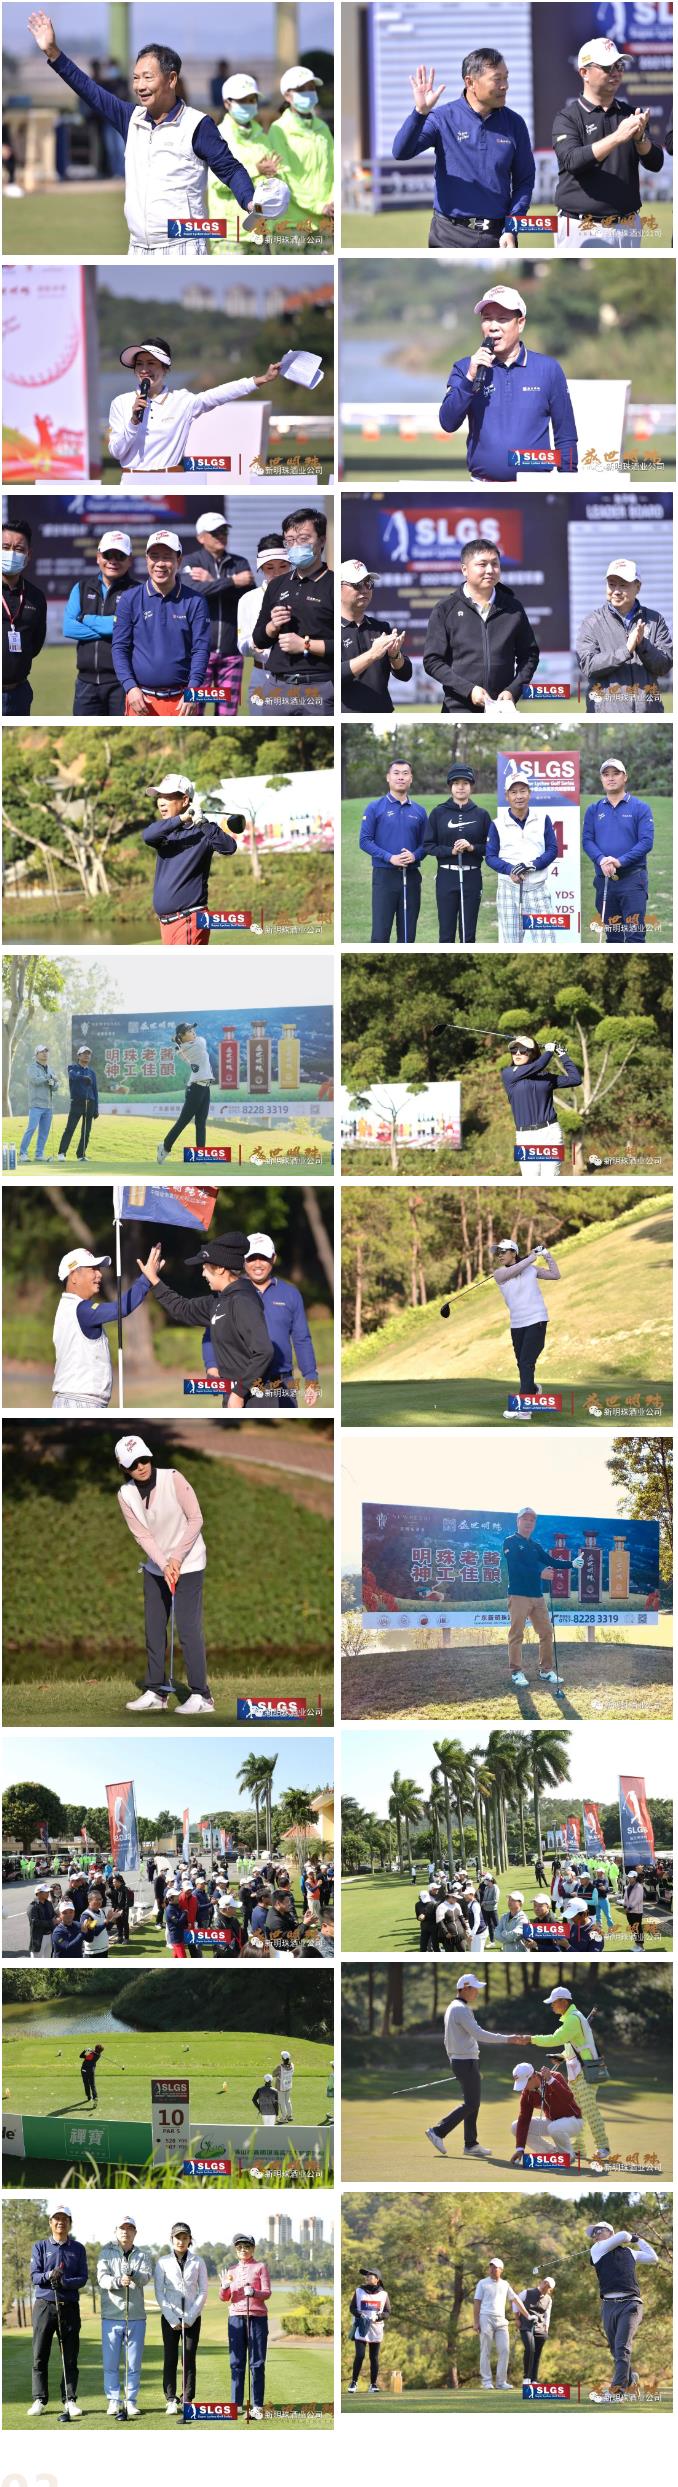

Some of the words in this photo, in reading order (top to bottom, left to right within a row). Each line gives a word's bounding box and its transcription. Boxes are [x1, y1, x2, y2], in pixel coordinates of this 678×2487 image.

[415, 517, 500, 546] SLGS
[519, 760, 575, 778] SLGS
[551, 867, 558, 877] 4
[555, 891, 575, 900] YDS
[555, 905, 575, 914] YDS
[105, 1048, 176, 1062] 明珠老酱
[105, 1062, 176, 1078] 神工佳酿
[242, 1105, 265, 1114] 8228
[266, 1105, 289, 1114] 3319
[411, 1547, 501, 1567] 明珠老酱
[411, 1564, 502, 1583] 神工佳酿
[597, 1614, 619, 1623] 3319
[161, 2083, 188, 2092] SLGS
[158, 2108, 184, 2126] 10
